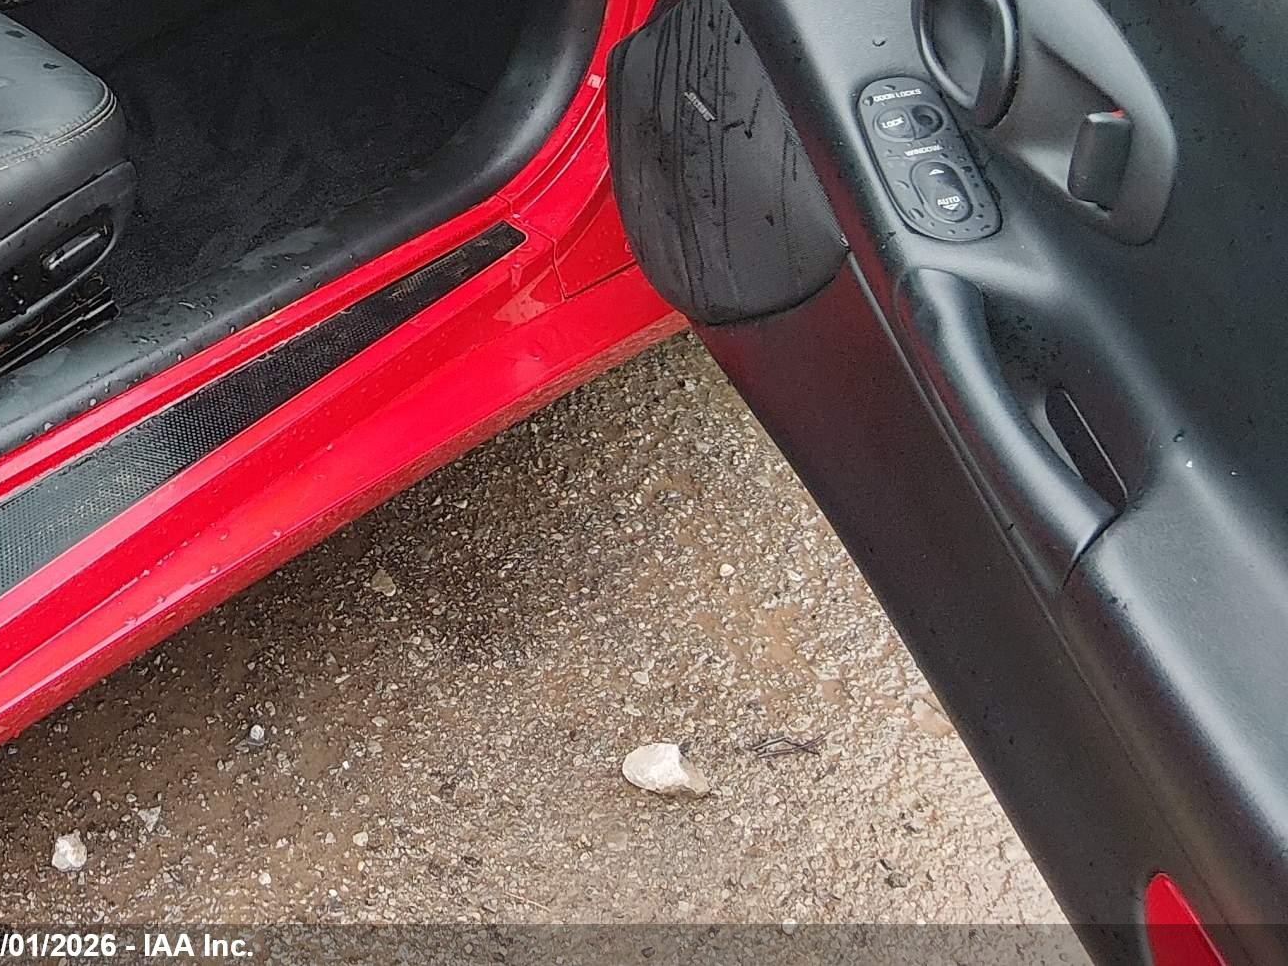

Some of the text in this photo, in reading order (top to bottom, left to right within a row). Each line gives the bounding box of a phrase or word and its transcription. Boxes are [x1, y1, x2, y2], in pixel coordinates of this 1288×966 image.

[873, 88, 922, 103] DOOR LOCKS
[881, 116, 904, 129] LOCK
[904, 144, 943, 156] WINDOW
[937, 195, 961, 206] AUTO
